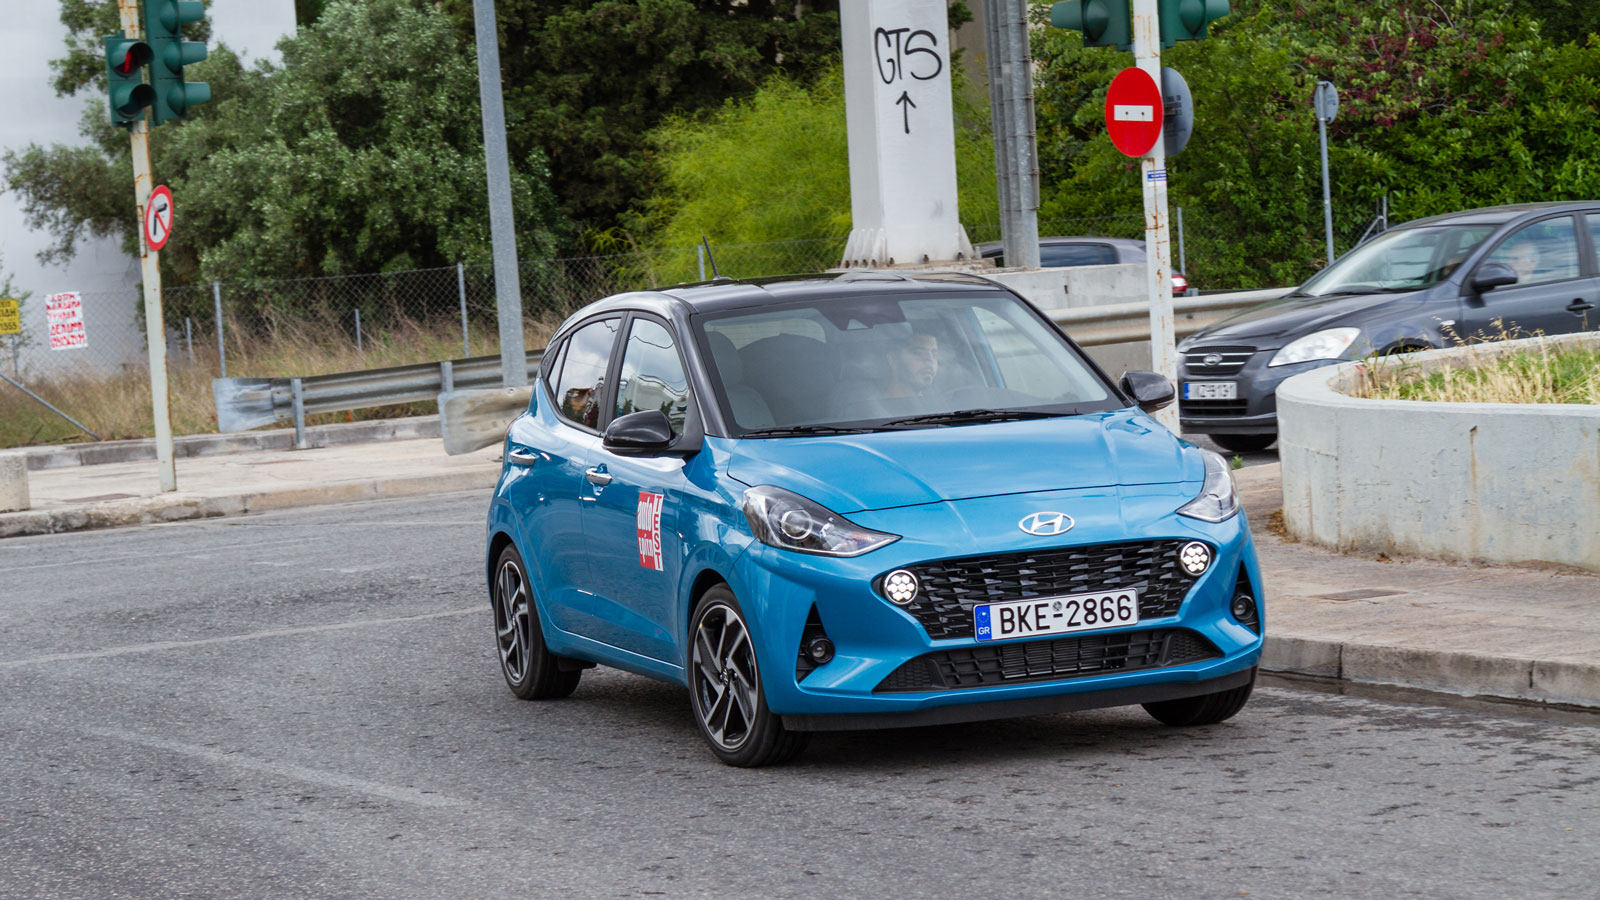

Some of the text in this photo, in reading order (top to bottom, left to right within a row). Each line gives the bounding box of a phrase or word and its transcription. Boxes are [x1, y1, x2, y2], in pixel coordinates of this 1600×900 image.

[874, 27, 942, 84] GTS
[638, 496, 652, 531] auto
[653, 495, 663, 569] TEST
[978, 626, 991, 635] GR
[999, 594, 1132, 635] BKE-2866
